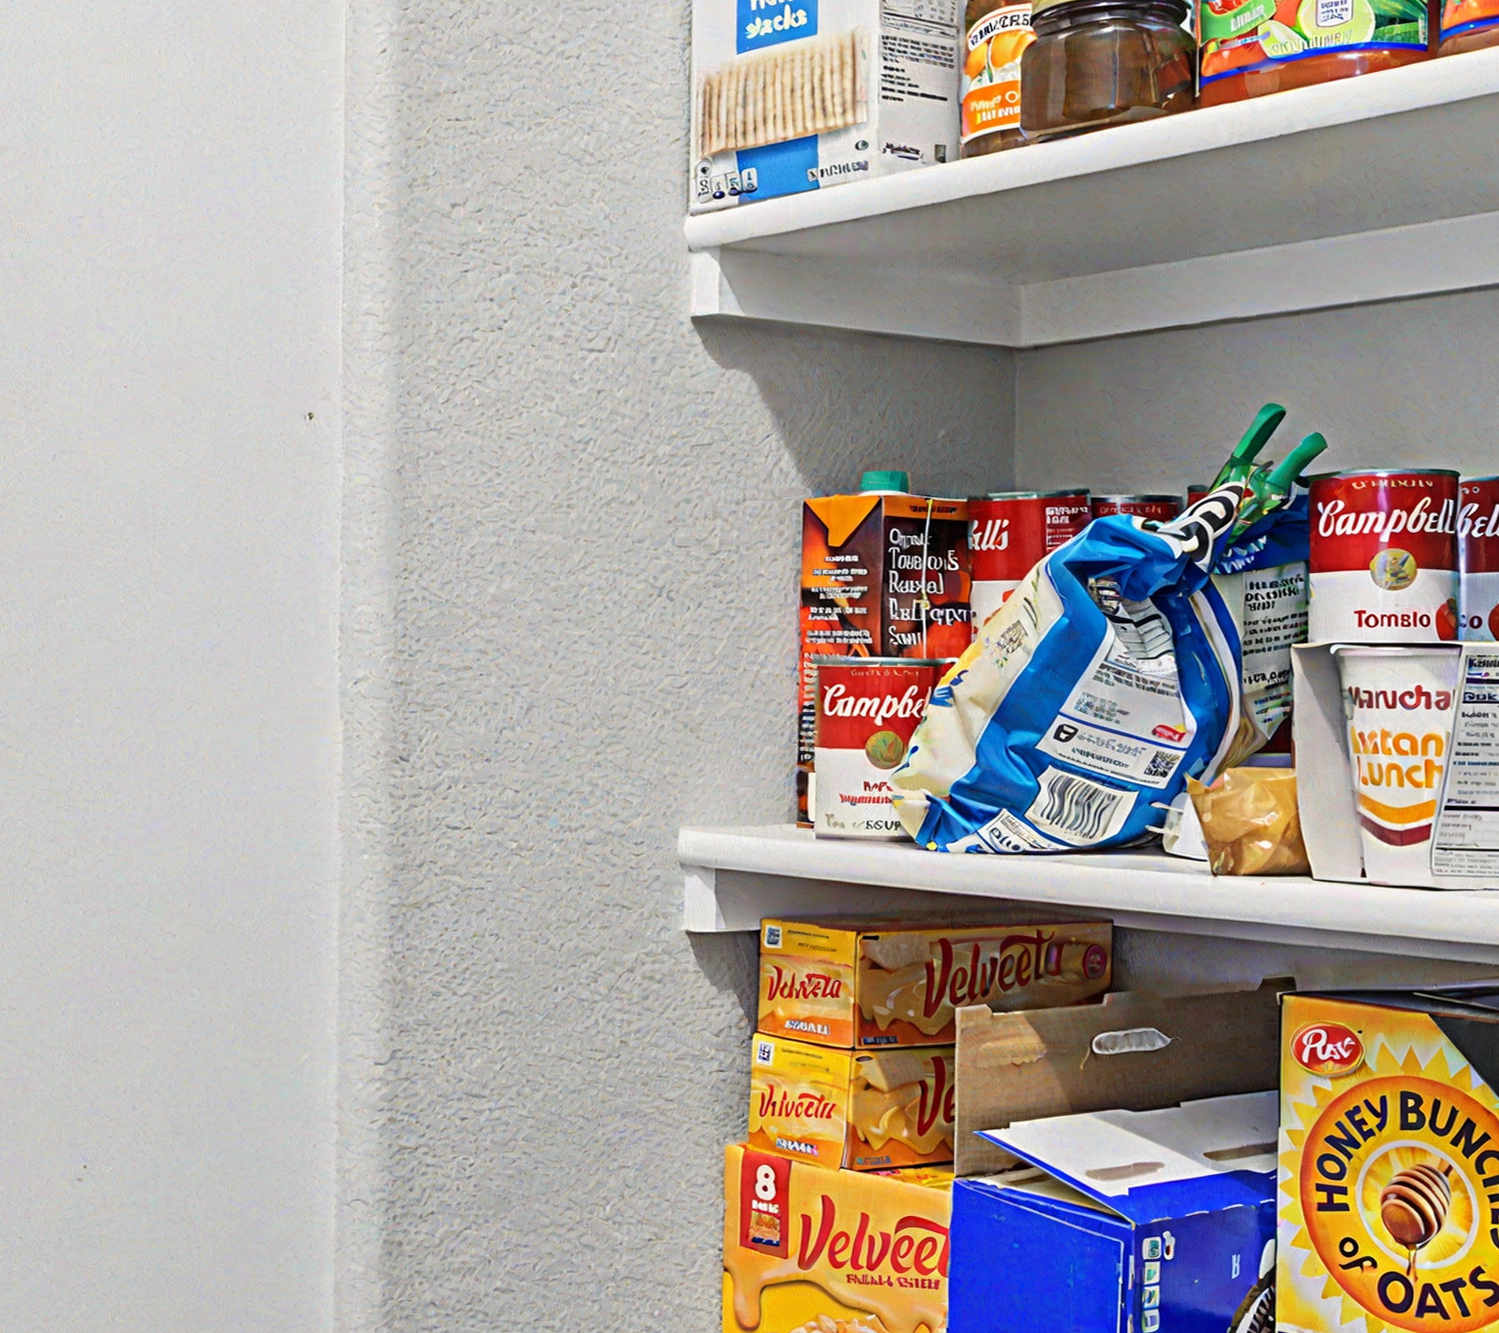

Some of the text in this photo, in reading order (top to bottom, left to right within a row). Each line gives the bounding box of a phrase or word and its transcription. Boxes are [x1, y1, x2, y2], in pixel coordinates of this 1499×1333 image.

[1316, 1092, 1388, 1213] HONEY
[754, 1163, 777, 1203] 8
[1338, 1235, 1376, 1271] of
